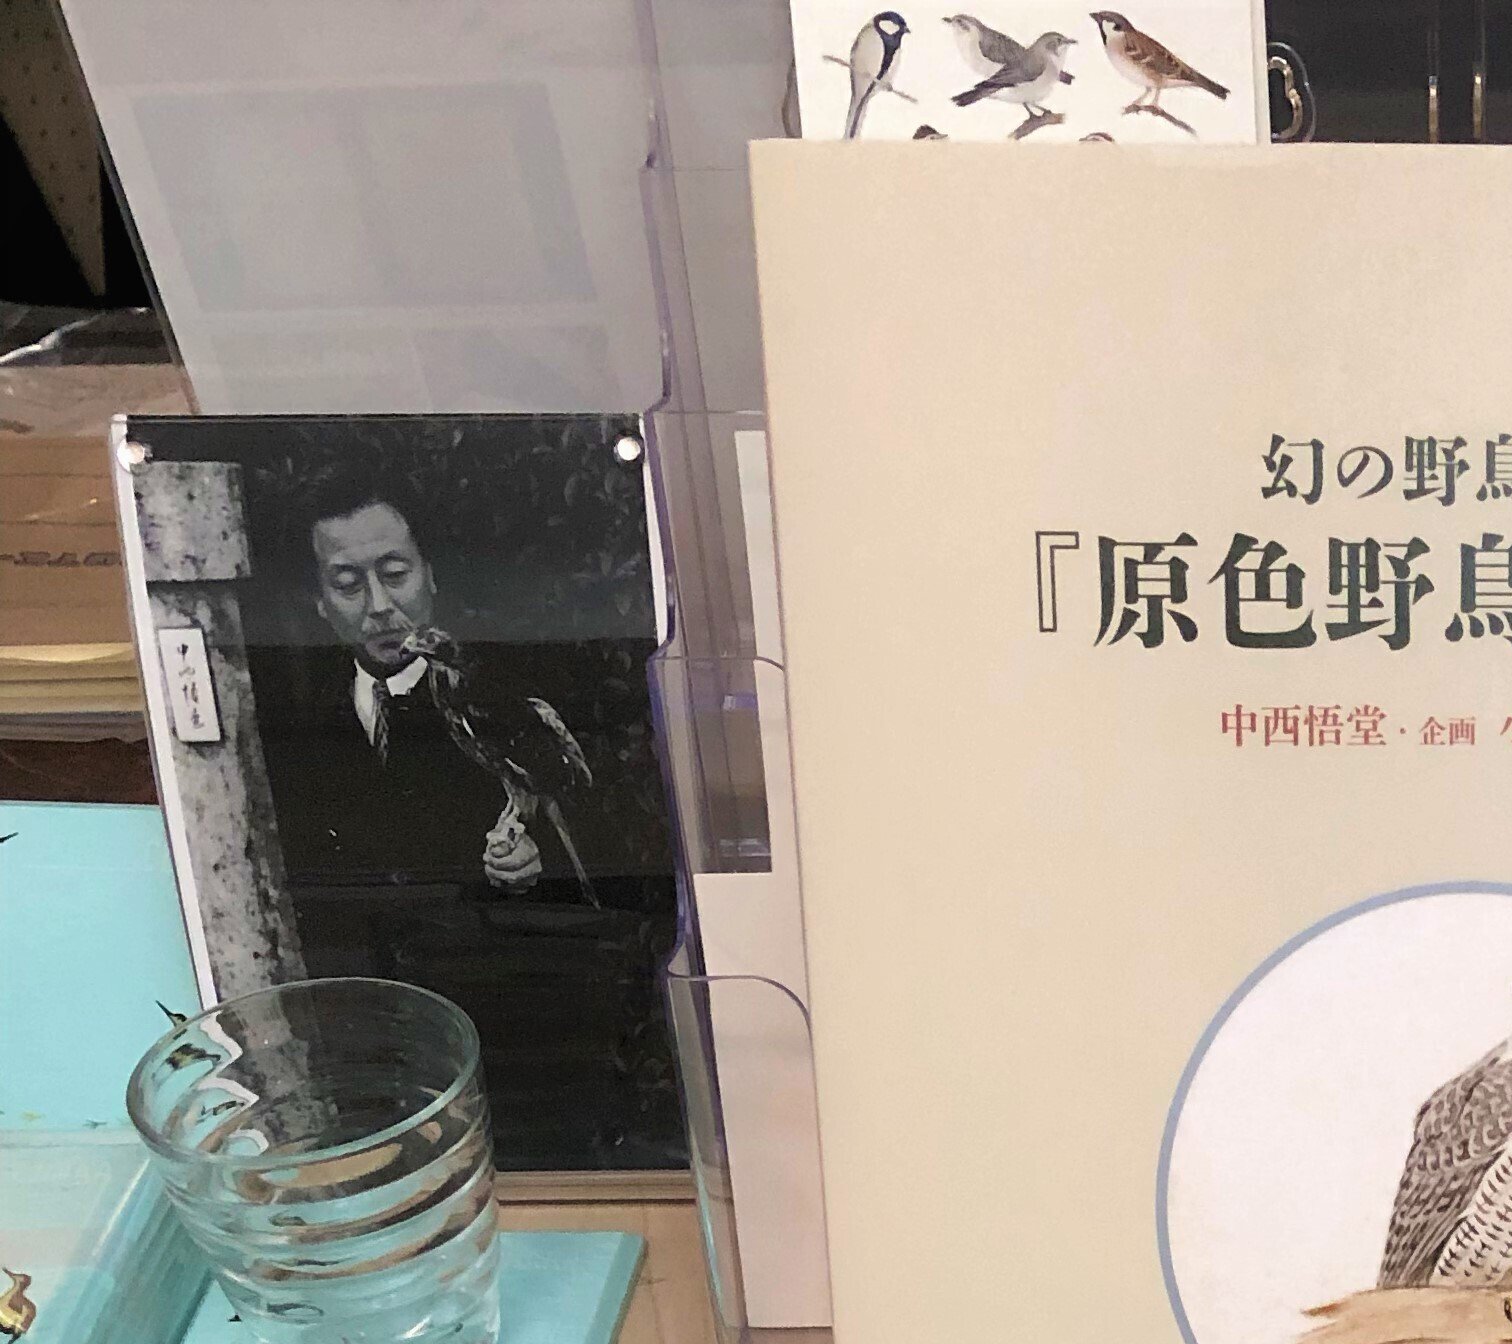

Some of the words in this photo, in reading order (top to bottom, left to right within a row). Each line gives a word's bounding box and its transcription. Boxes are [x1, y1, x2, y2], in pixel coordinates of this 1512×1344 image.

[1220, 702, 1477, 748] 中西悟堂・企画
